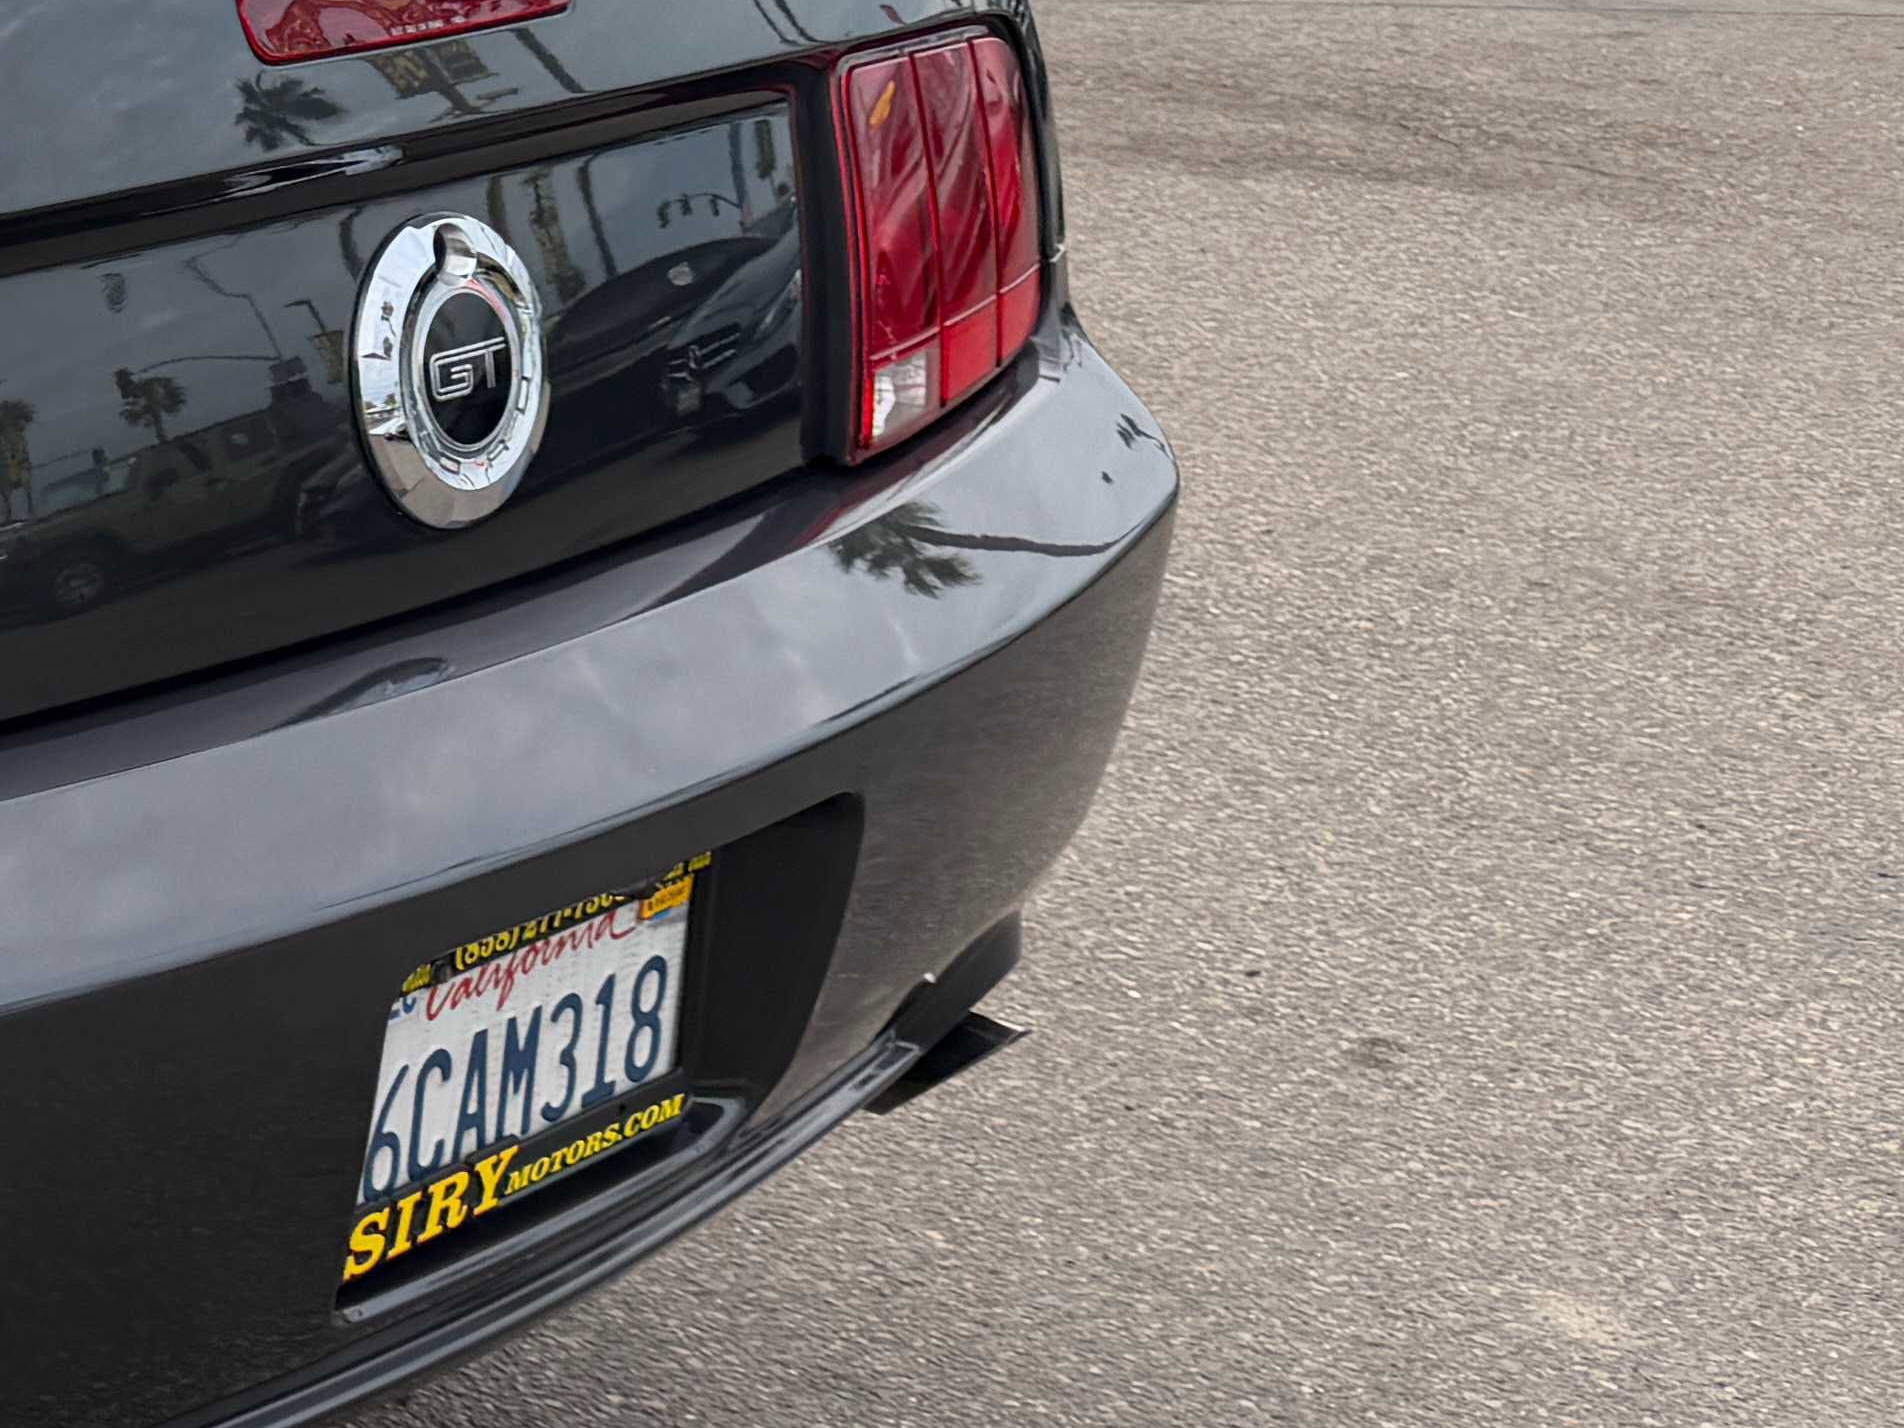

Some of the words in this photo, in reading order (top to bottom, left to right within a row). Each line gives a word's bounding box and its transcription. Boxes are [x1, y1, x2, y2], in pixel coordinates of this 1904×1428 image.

[428, 336, 509, 403] GT
[426, 909, 639, 1022] California
[362, 954, 669, 1203] 6CAM318
[343, 1144, 520, 1283] SIRY
[505, 1092, 685, 1196] MOTORS.COM
